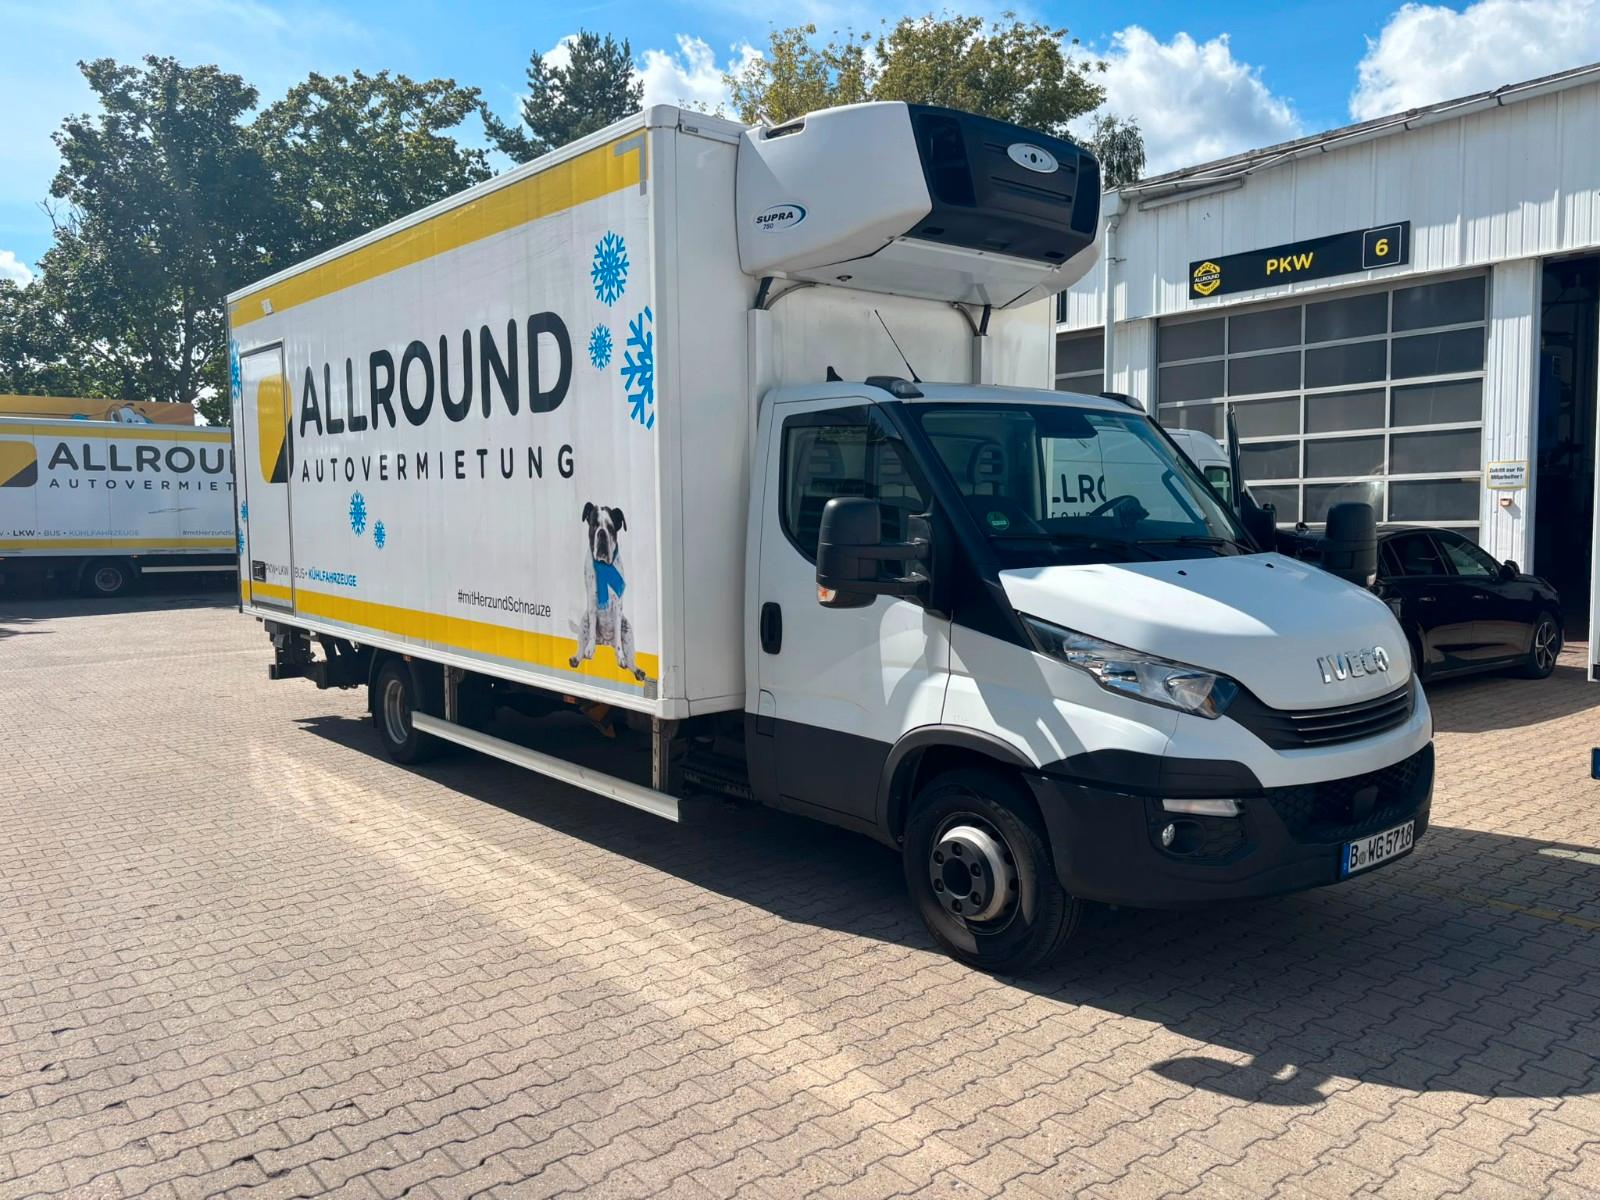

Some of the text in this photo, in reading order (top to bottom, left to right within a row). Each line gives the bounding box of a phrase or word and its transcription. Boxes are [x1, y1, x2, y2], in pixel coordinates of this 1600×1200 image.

[756, 211, 794, 224] SUPRA
[1375, 238, 1389, 257] 6
[1266, 252, 1314, 276] PKW
[299, 311, 573, 438] ALLROUND
[302, 445, 575, 484] AUTOVERMIETUNG
[13, 529, 35, 537] LKW
[44, 529, 60, 537] BUS
[308, 567, 358, 587] KÜHLFAHRZEUGE
[457, 588, 551, 618] #mitHerzundSchnauze
[1317, 646, 1389, 684] IVECO
[1350, 845, 1359, 869] B
